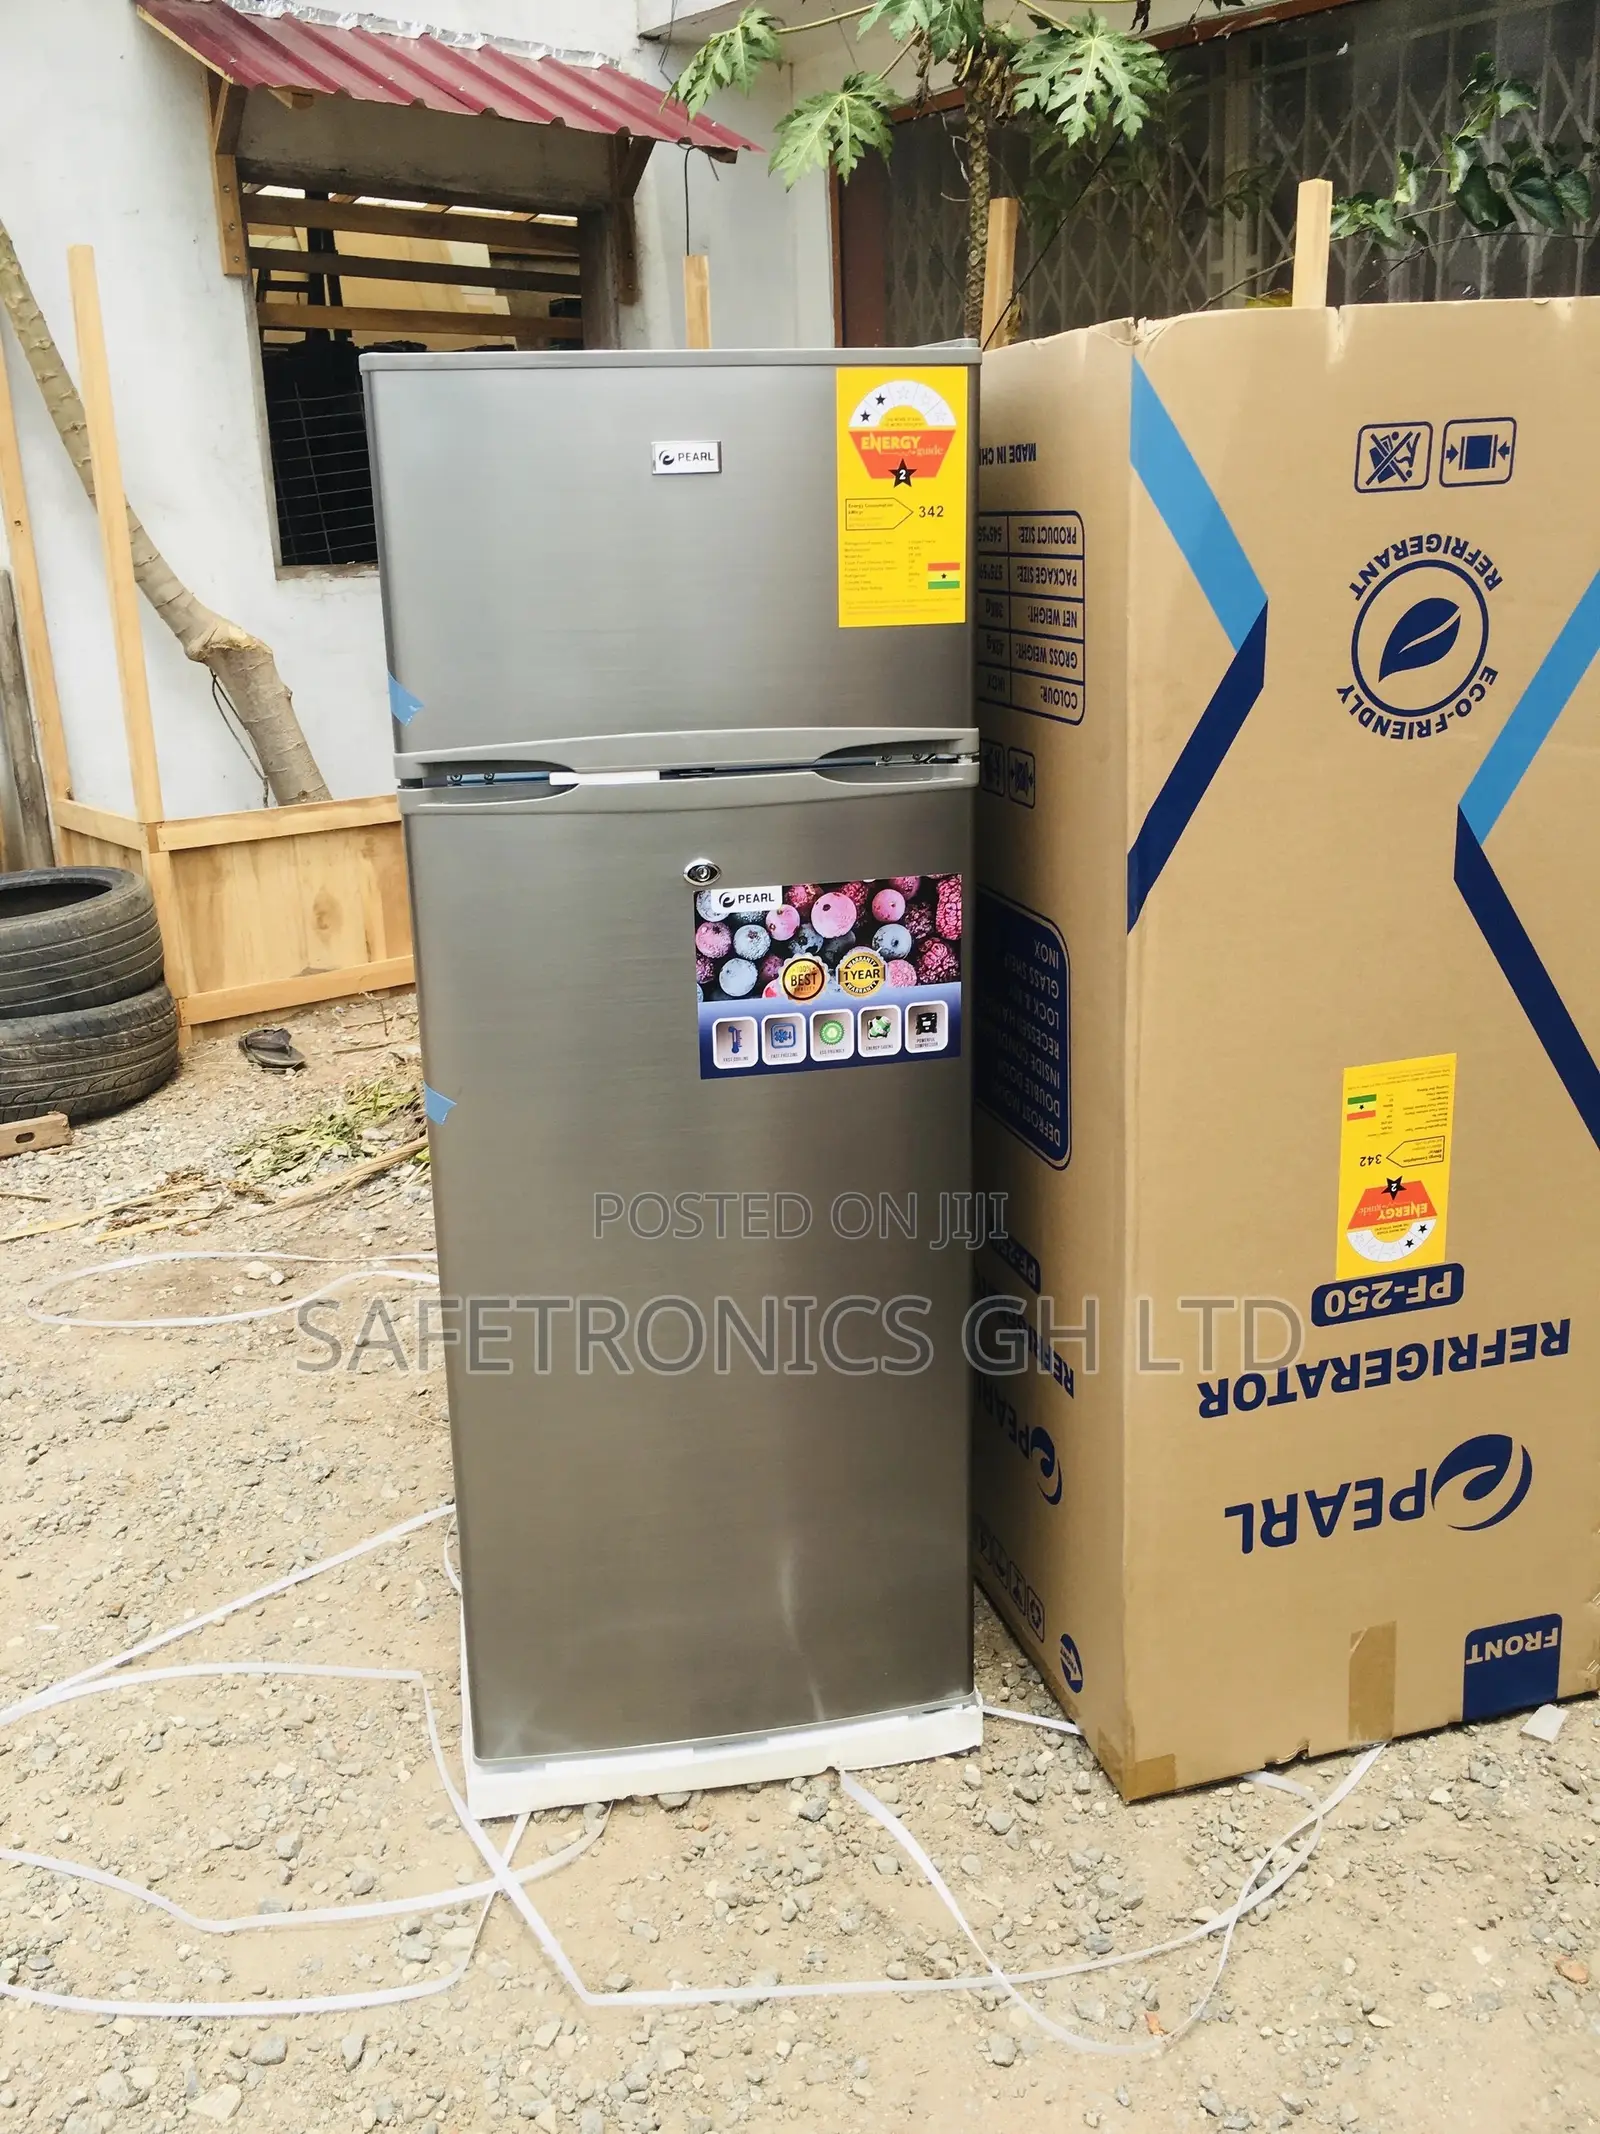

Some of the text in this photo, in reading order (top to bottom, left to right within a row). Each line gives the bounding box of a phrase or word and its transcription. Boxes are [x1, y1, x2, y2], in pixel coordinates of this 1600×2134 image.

[860, 432, 921, 455] ENERGY
[996, 445, 1006, 464] IN
[1008, 442, 1037, 463] MADE
[678, 452, 715, 461] PEARL
[899, 470, 906, 480] 2
[919, 505, 944, 518] 342
[1017, 525, 1077, 544] PRODUCT SIZE:
[1016, 565, 1077, 587] PACKAGE SIZE:
[1349, 532, 1502, 602] REFRIGERANT
[1026, 604, 1077, 628] NET WEIGHT:
[1014, 642, 1078, 669] GROSS WEIGHT:
[1039, 684, 1078, 710] COLOUR:
[1336, 664, 1498, 740] ECO-FRIENDLY
[738, 893, 774, 904] PEARL
[846, 956, 878, 968] WARRANTY
[1032, 937, 1059, 970] INOX
[791, 972, 817, 987] BEST
[847, 981, 878, 993] WARRANTY
[1028, 965, 1059, 999] GLASS
[1032, 996, 1059, 1030] LOCK
[1029, 1051, 1060, 1090] INSIDE
[1024, 1076, 1060, 1118] DOUBLE
[1022, 1101, 1060, 1147] DEFROST
[1358, 1153, 1381, 1167] 342
[1390, 1182, 1397, 1191] 2
[1376, 1200, 1428, 1220] ENERGY
[1324, 1270, 1452, 1317] PF-250
[1196, 1317, 1570, 1418] REFRIGERATOR
[1223, 1467, 1427, 1554] PEARL
[1465, 1626, 1558, 1664] FRONT
